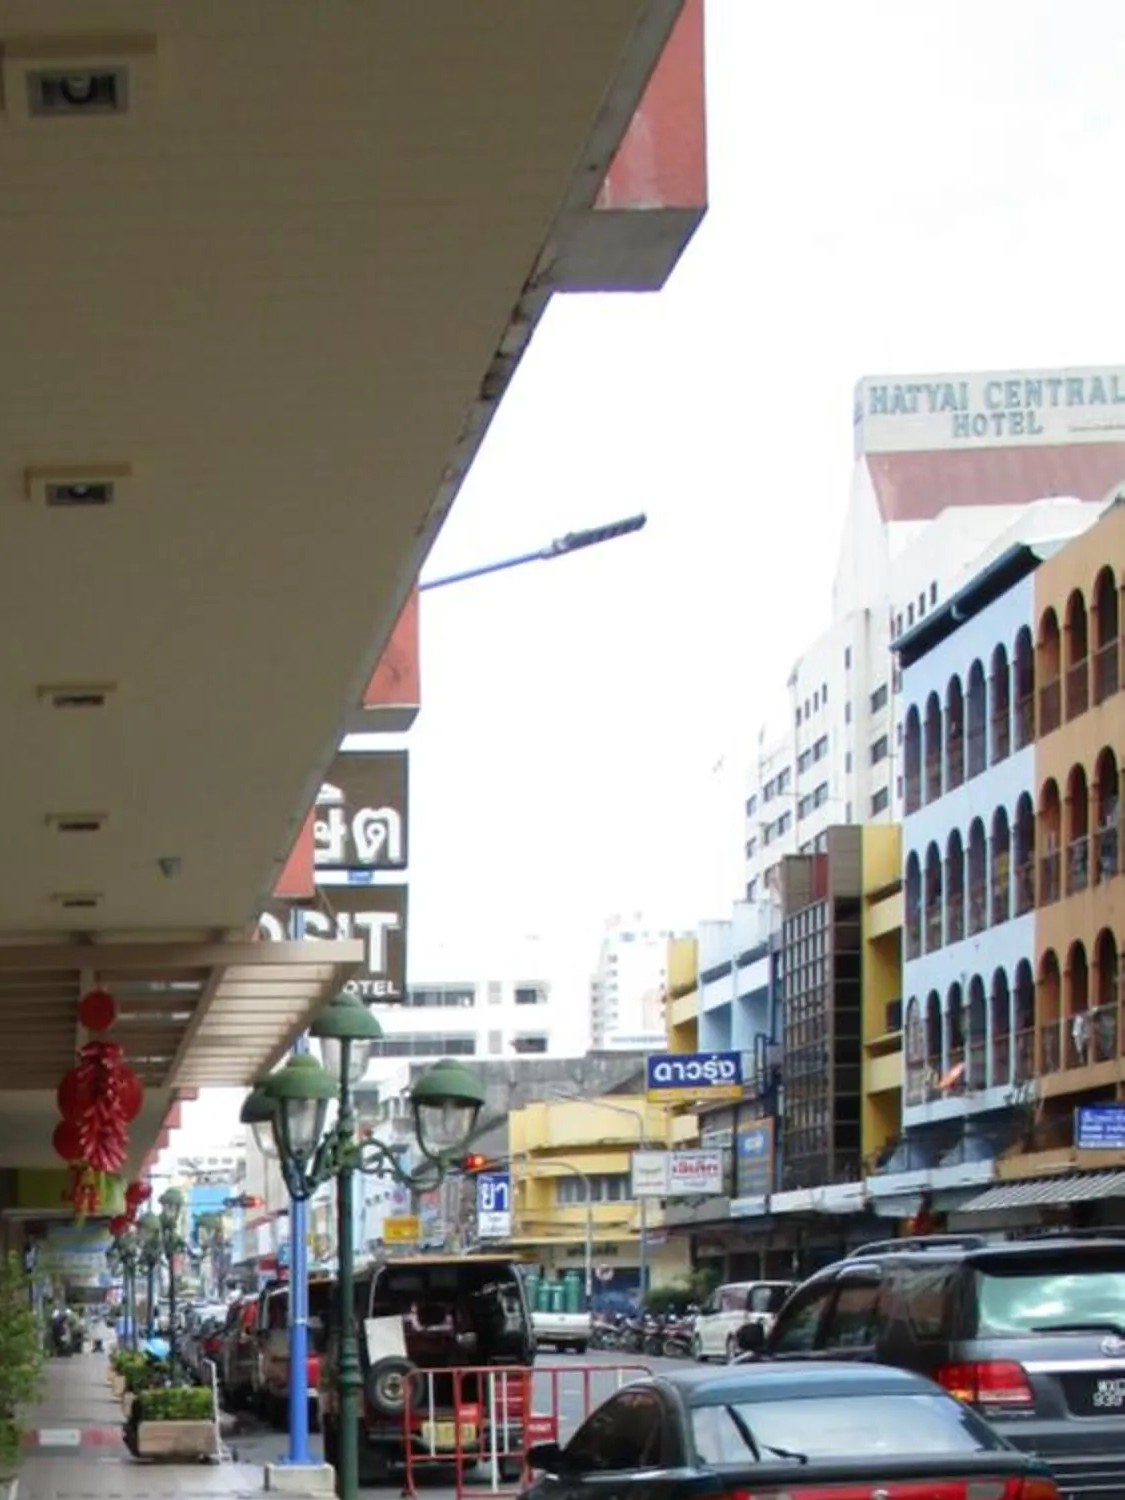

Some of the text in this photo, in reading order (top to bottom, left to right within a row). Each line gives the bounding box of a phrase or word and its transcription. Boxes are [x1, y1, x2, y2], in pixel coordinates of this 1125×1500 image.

[869, 374, 1125, 416] HATYAI CENTRAL
[952, 410, 1043, 438] HOTEL
[342, 979, 400, 997] OTEL
